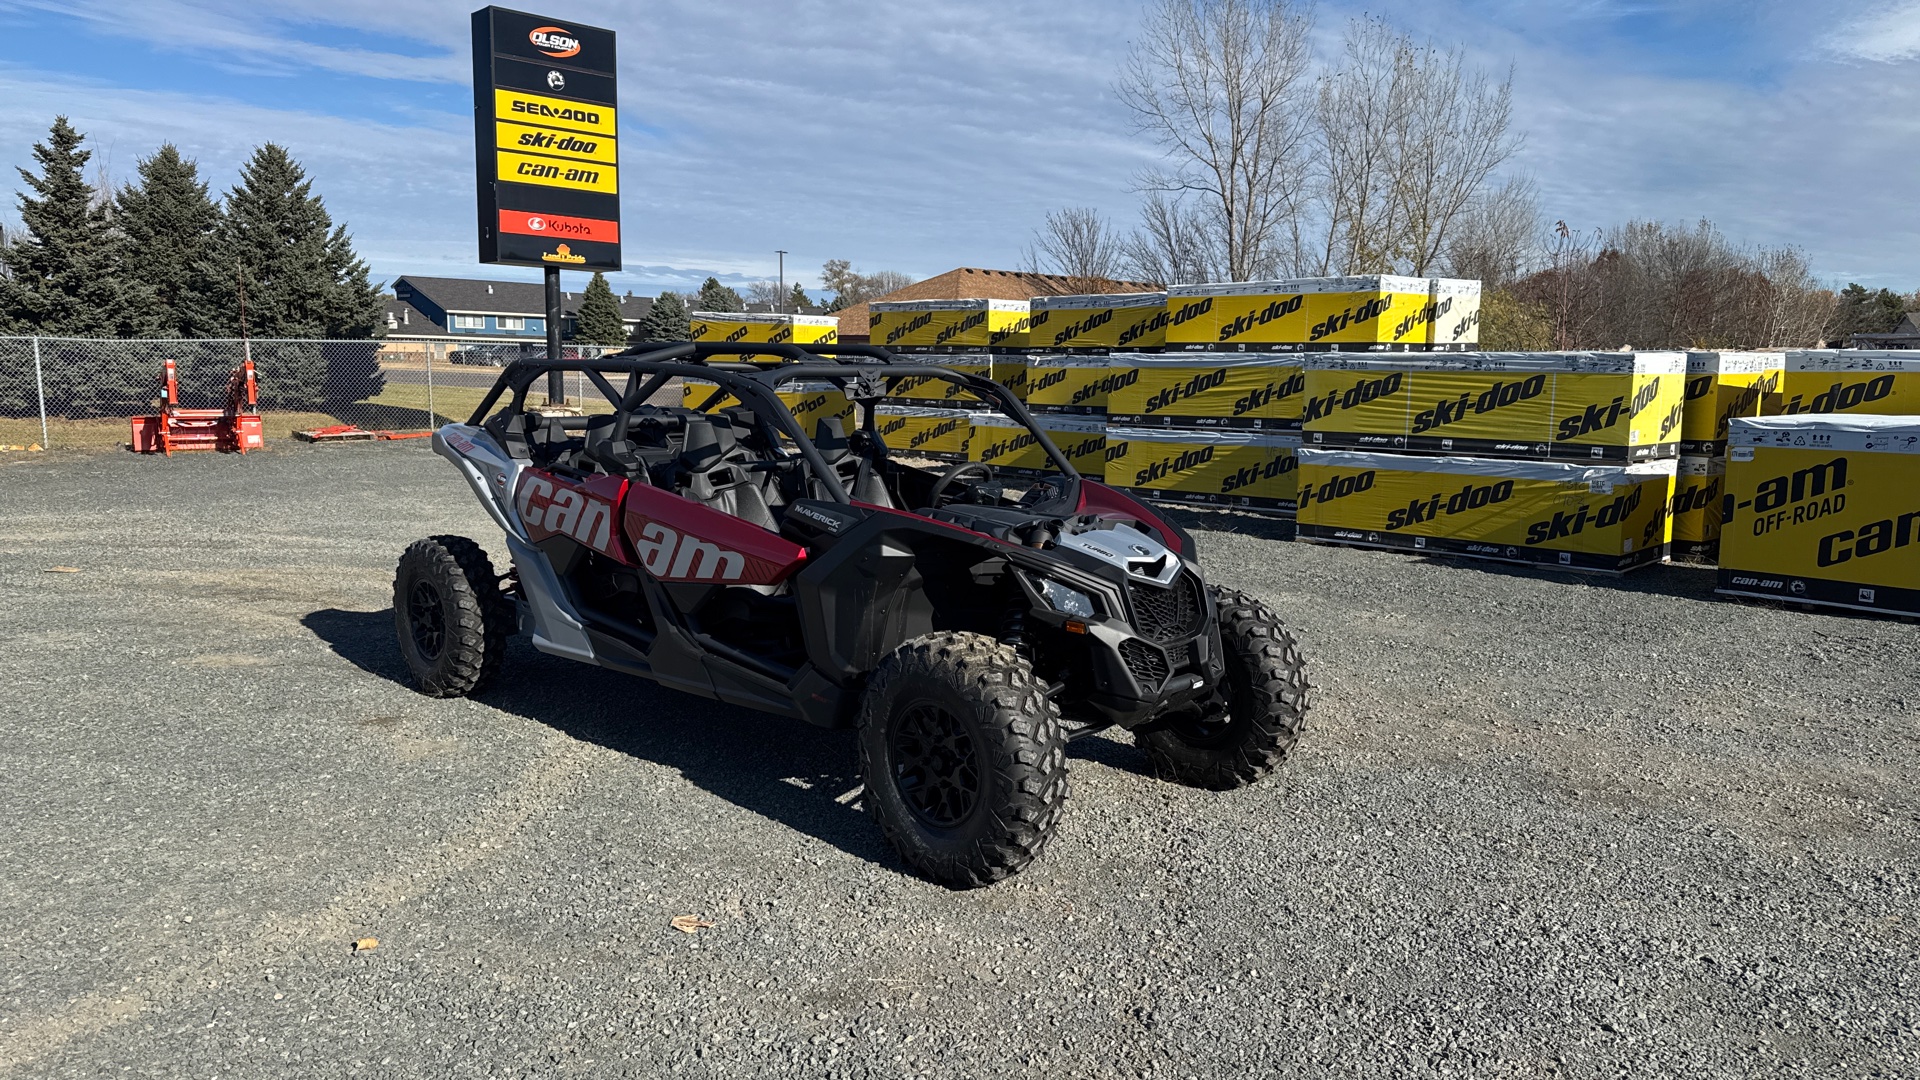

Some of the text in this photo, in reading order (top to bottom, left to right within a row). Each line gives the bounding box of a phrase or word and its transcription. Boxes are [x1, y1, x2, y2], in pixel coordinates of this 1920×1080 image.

[532, 31, 579, 49] OLSON
[517, 131, 598, 154] ski-doo
[516, 162, 600, 184] can-am
[548, 219, 592, 235] Kubota
[886, 312, 933, 345] ski-doo
[936, 310, 987, 345] ski-doo
[1054, 308, 1113, 346] ski-doo
[1219, 294, 1304, 342] ski-doo
[1309, 293, 1393, 341] ski-doo
[1144, 368, 1227, 414] ski-doo
[1303, 372, 1404, 424] ki-doo
[1411, 373, 1547, 434] ski-doo
[1555, 376, 1660, 441] ski-doo
[1781, 374, 1896, 415] i-doo
[910, 419, 957, 449] ski-doo
[1134, 445, 1215, 487] ski-doo
[794, 504, 842, 529] MAVERICK
[1385, 479, 1515, 530] ski-doo
[1525, 484, 1643, 545] ski-doo
[1753, 493, 1846, 537] OFF-ROAD
[1081, 542, 1114, 558] TURBO
[1334, 531, 1363, 539] ski-doo
[1466, 544, 1499, 553] ski-doo
[1731, 576, 1784, 589] can-am
